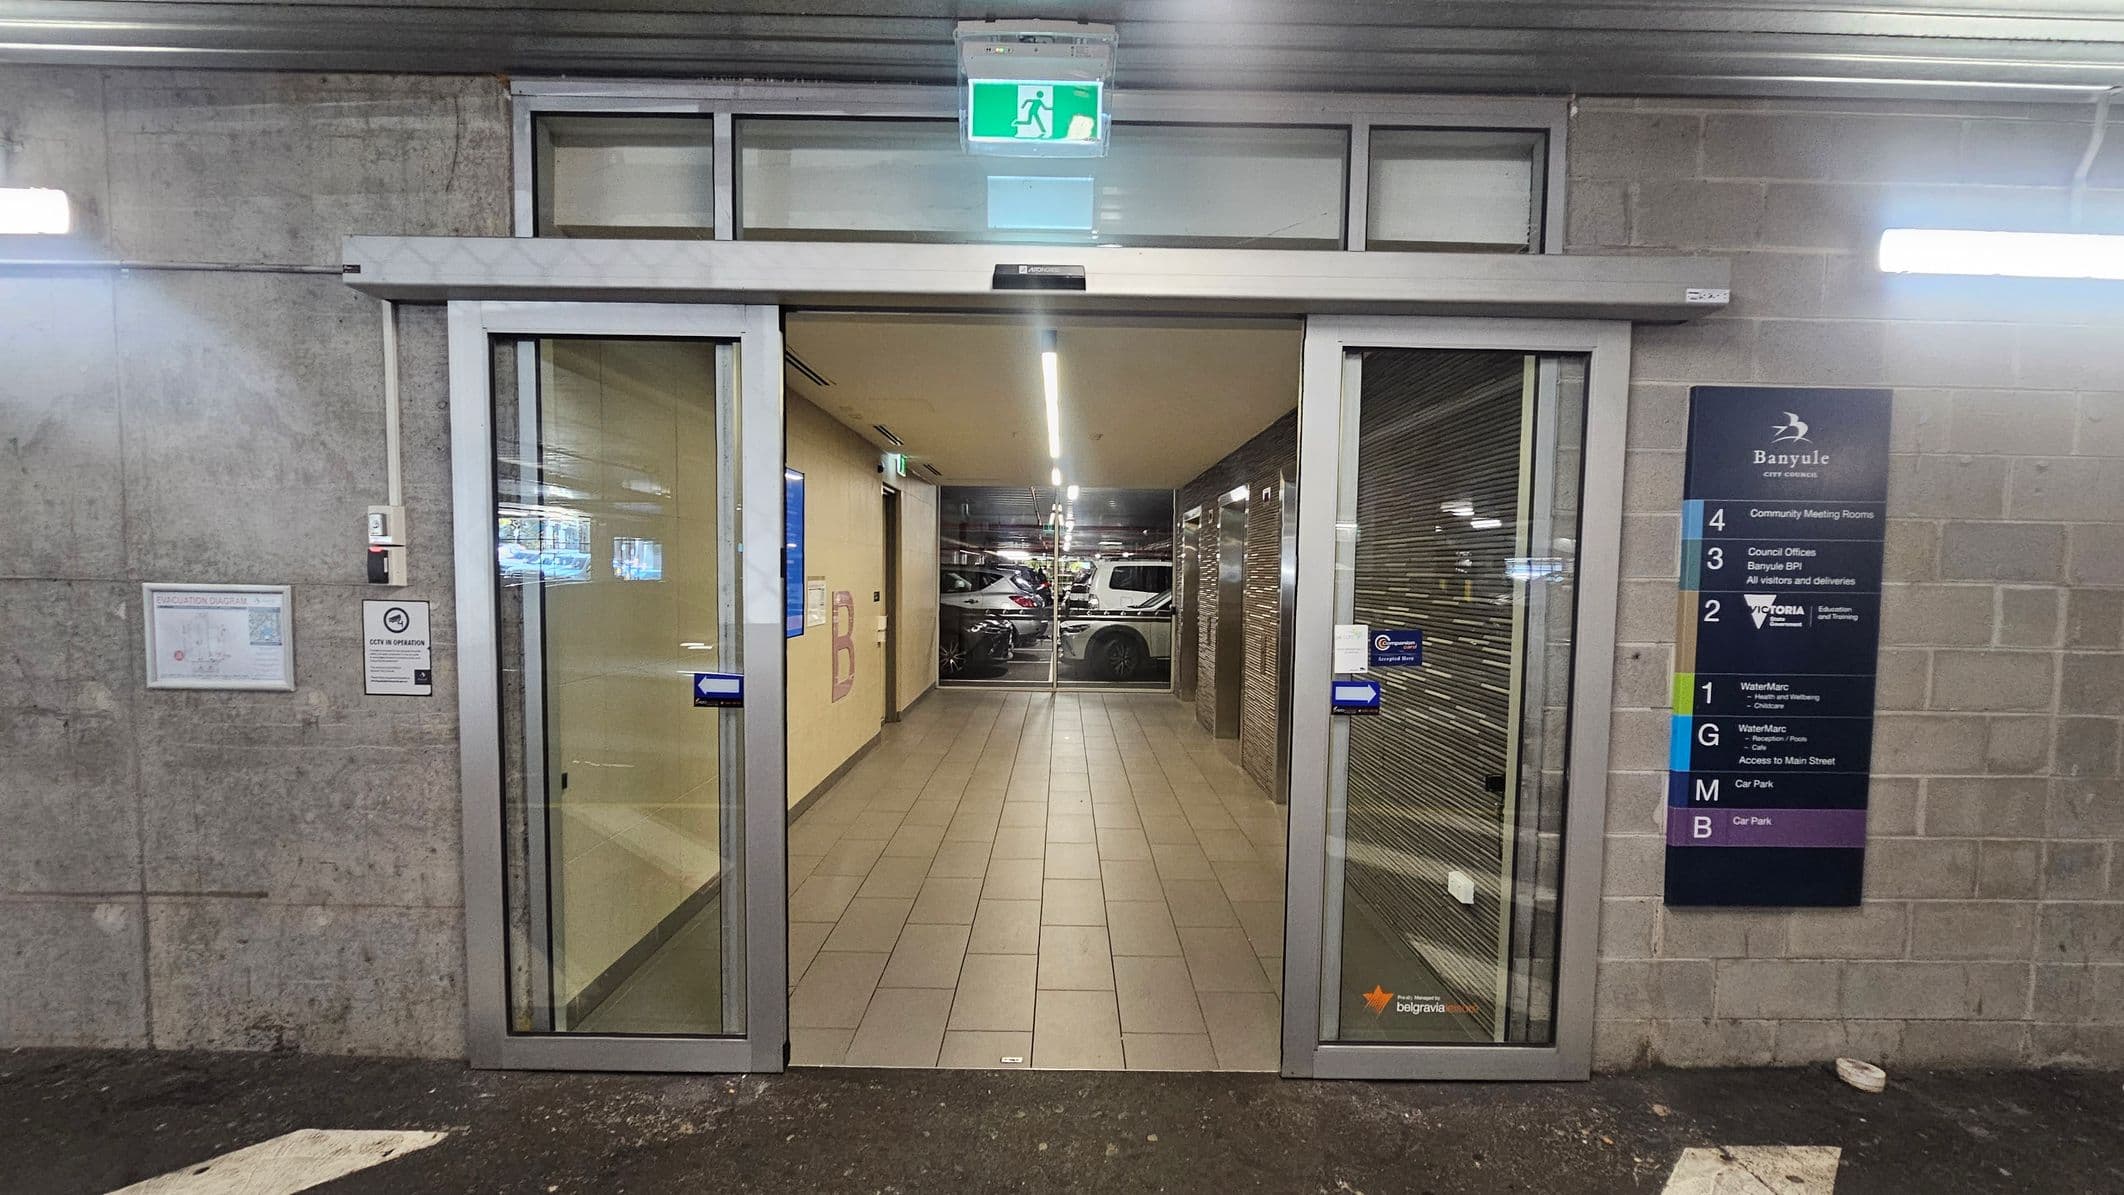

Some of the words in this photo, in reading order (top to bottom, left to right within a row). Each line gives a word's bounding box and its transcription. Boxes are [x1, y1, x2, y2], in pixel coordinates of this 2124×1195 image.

[1753, 450, 1830, 468] Banyule
[1750, 508, 1801, 520] Community
[1803, 510, 1840, 520] Meeting
[1842, 510, 1875, 519] Rooms
[1709, 508, 1726, 532] 4
[1747, 547, 1782, 557] Council
[1784, 548, 1817, 557] Offices
[1706, 547, 1724, 570] 3
[1747, 561, 1783, 572] Banyule
[1785, 562, 1802, 570] BPI
[1746, 576, 1759, 584] All
[1760, 576, 1792, 585] visitors
[1794, 577, 1812, 585] and
[1813, 577, 1856, 586] deliveries
[156, 596, 208, 605] EVACUATION
[209, 597, 248, 605] DIAGRAM
[1703, 599, 1721, 622] 2
[1750, 605, 1805, 615] VICTORIA
[1832, 613, 1859, 621] Training
[832, 591, 855, 704] B
[1740, 682, 1790, 691] WaterMarc
[1702, 682, 1713, 704] 1
[1738, 724, 1787, 733] WaterMarc
[1698, 723, 1720, 746] G
[1752, 735, 1784, 743] Reception
[1738, 756, 1772, 765] Access
[1773, 757, 1783, 765] to
[1784, 756, 1807, 765] Main
[1808, 756, 1836, 765] Street
[1735, 780, 1751, 788] Car
[1753, 780, 1774, 788] Park
[1695, 779, 1719, 801] M
[1733, 816, 1748, 825] Car
[1751, 817, 1772, 825] Park
[1693, 816, 1712, 838] B
[1396, 1002, 1445, 1014] belgravia
